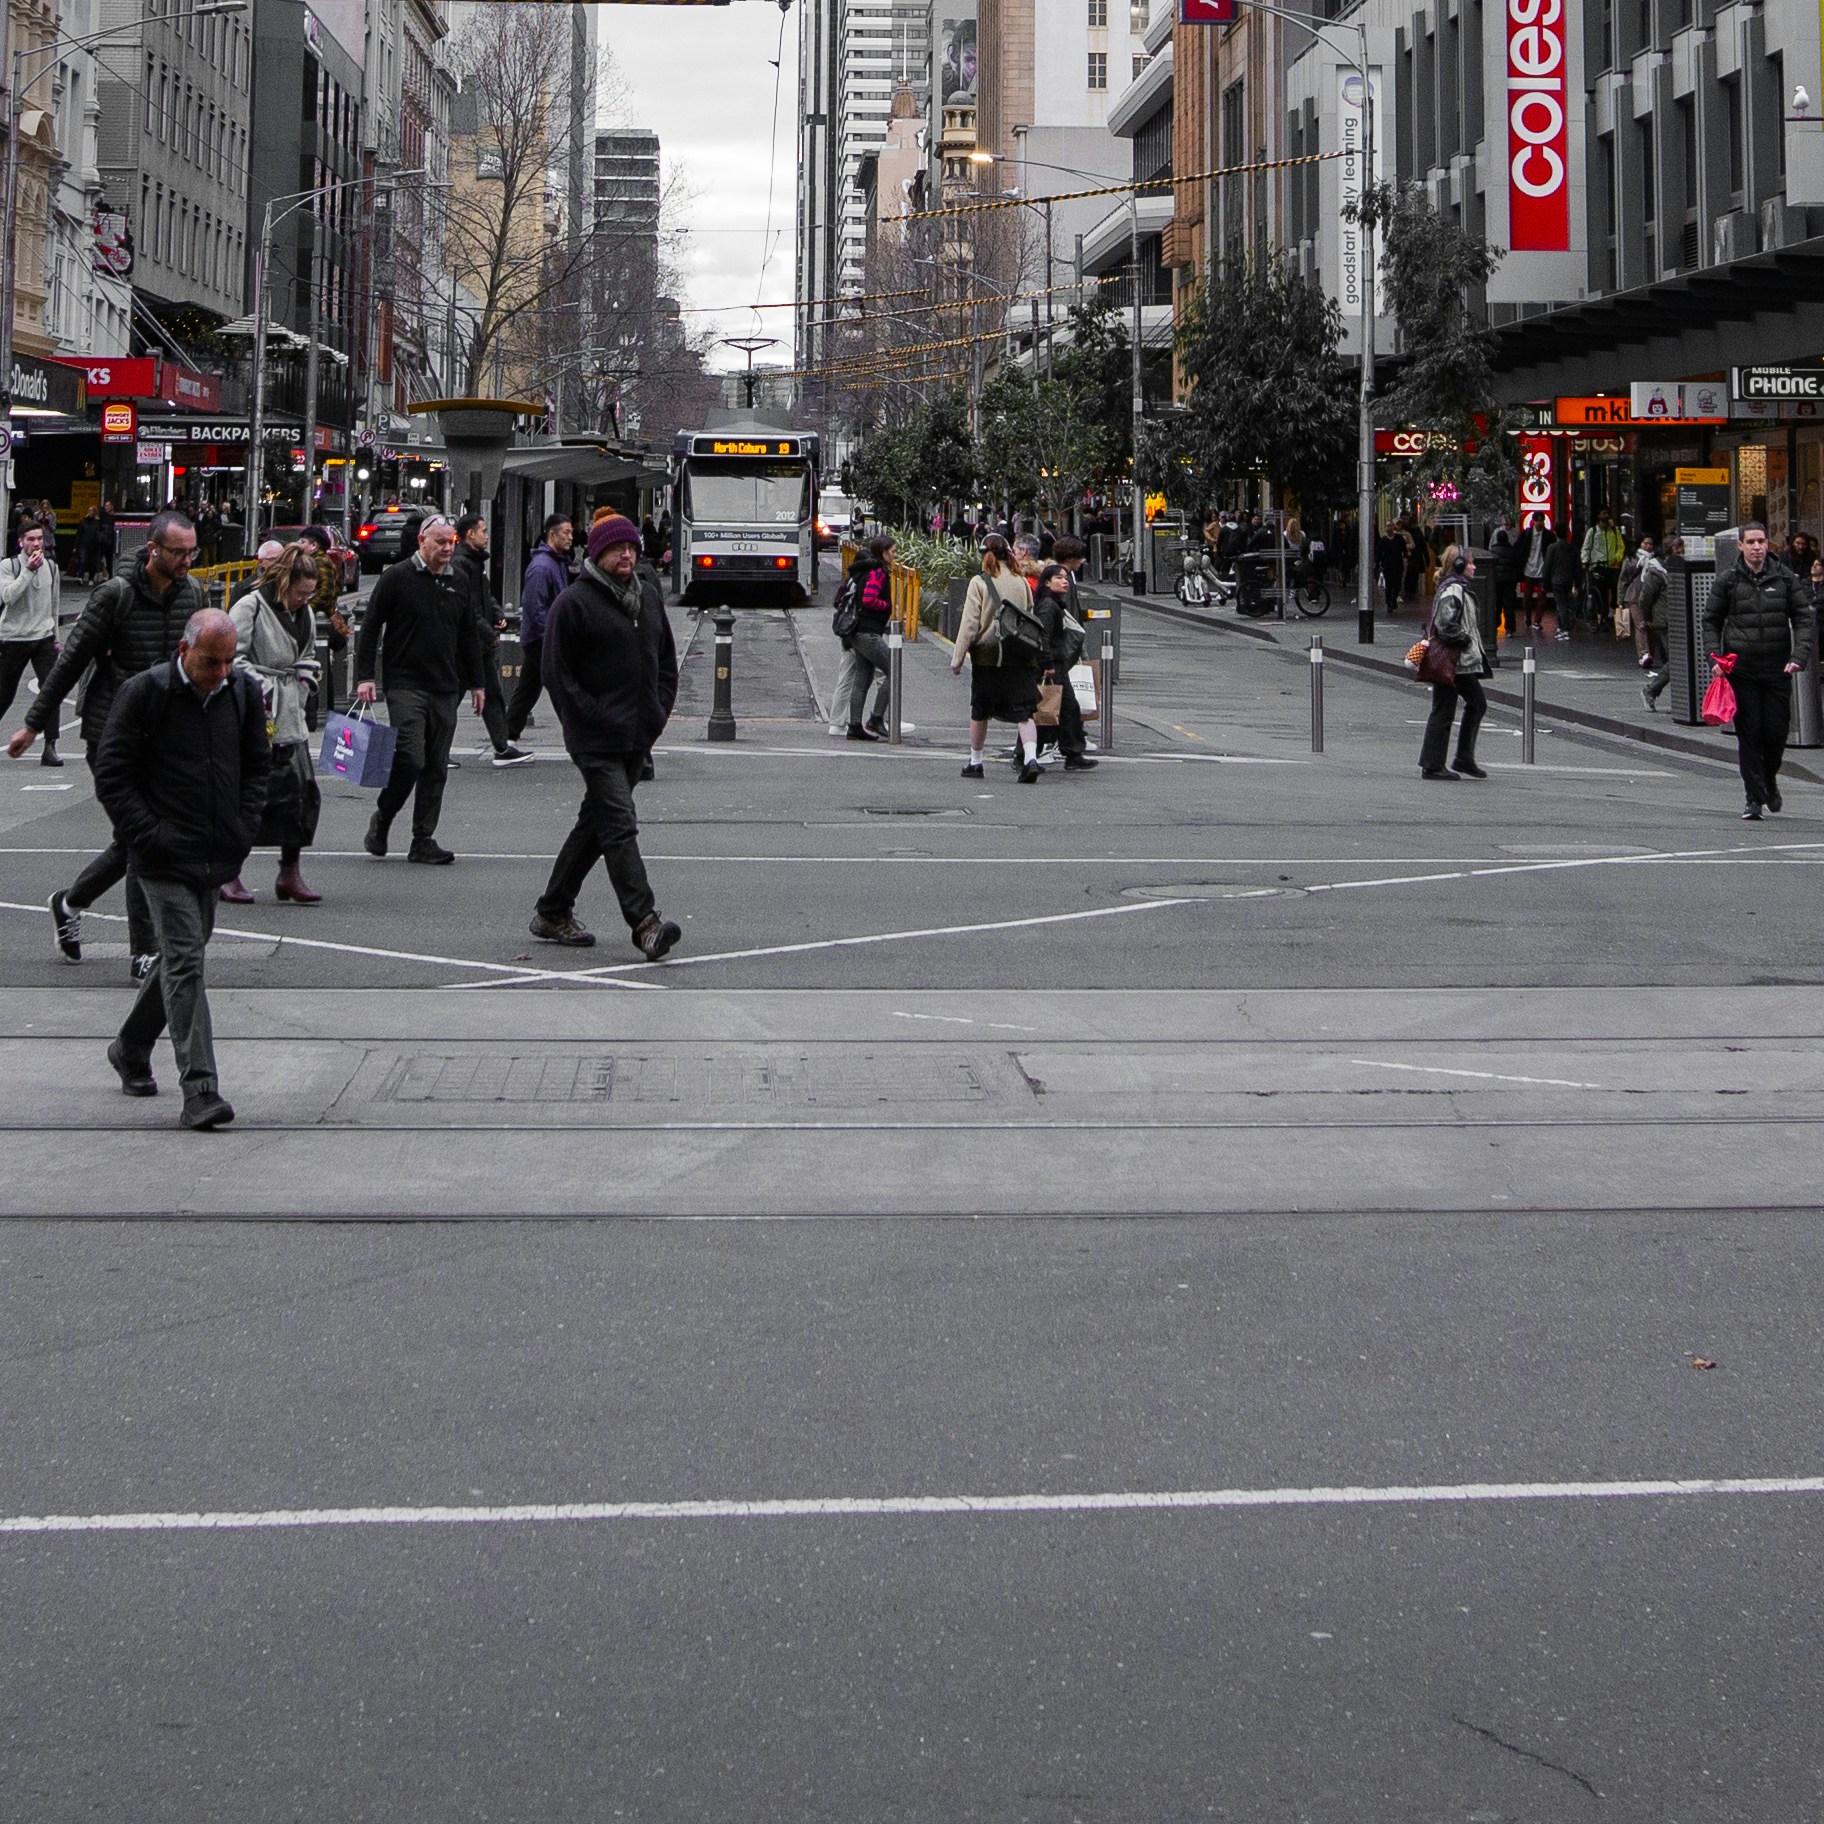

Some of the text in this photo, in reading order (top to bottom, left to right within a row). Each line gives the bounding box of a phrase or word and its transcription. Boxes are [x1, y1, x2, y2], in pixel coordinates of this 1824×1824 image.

[1343, 229, 1359, 305] goodstart
[1752, 366, 1792, 375] MOBILE
[1749, 377, 1818, 395] PHONE
[191, 425, 301, 441] BACKPAKERS
[714, 442, 789, 454] North 19
[776, 511, 796, 521] 2012
[762, 532, 787, 541] Globally
